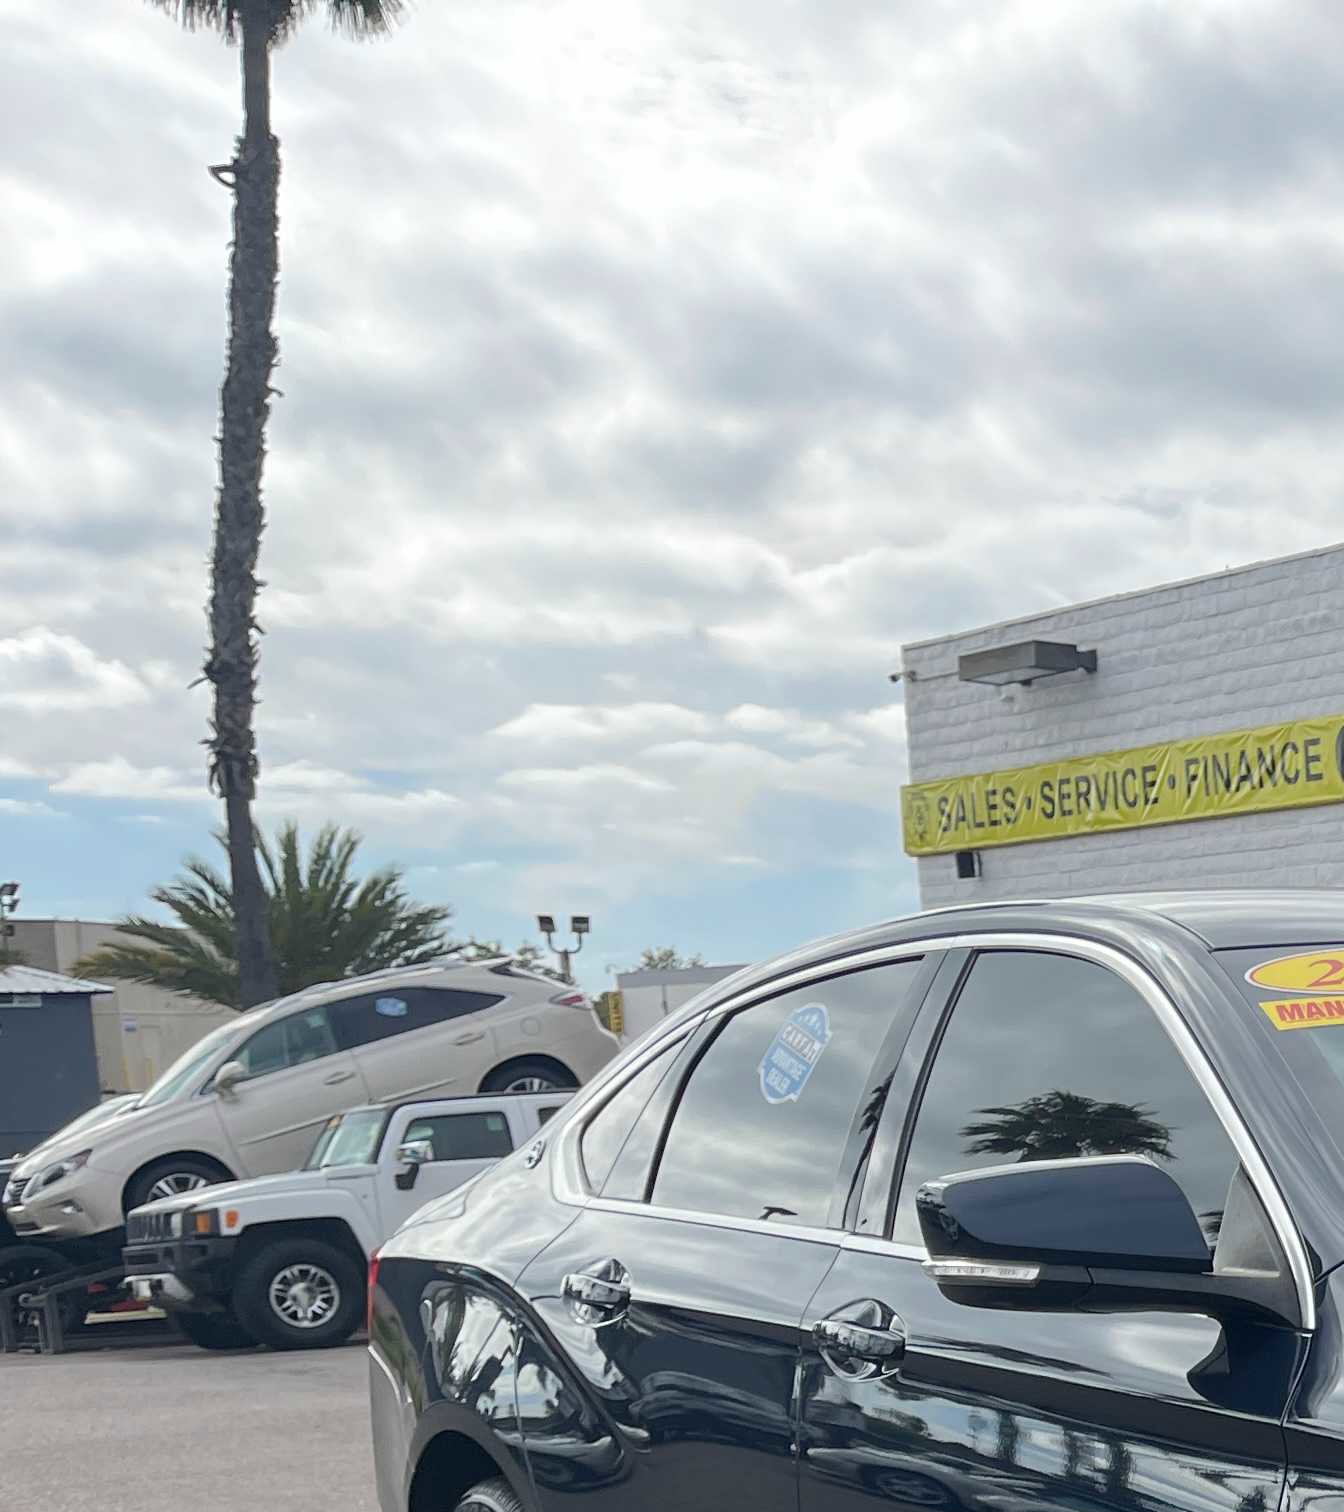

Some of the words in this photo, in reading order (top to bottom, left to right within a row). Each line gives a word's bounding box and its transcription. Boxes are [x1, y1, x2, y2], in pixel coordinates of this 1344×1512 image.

[936, 785, 1019, 834] SALES
[1039, 764, 1160, 820] SERVICE
[1185, 737, 1324, 798] FINANCE
